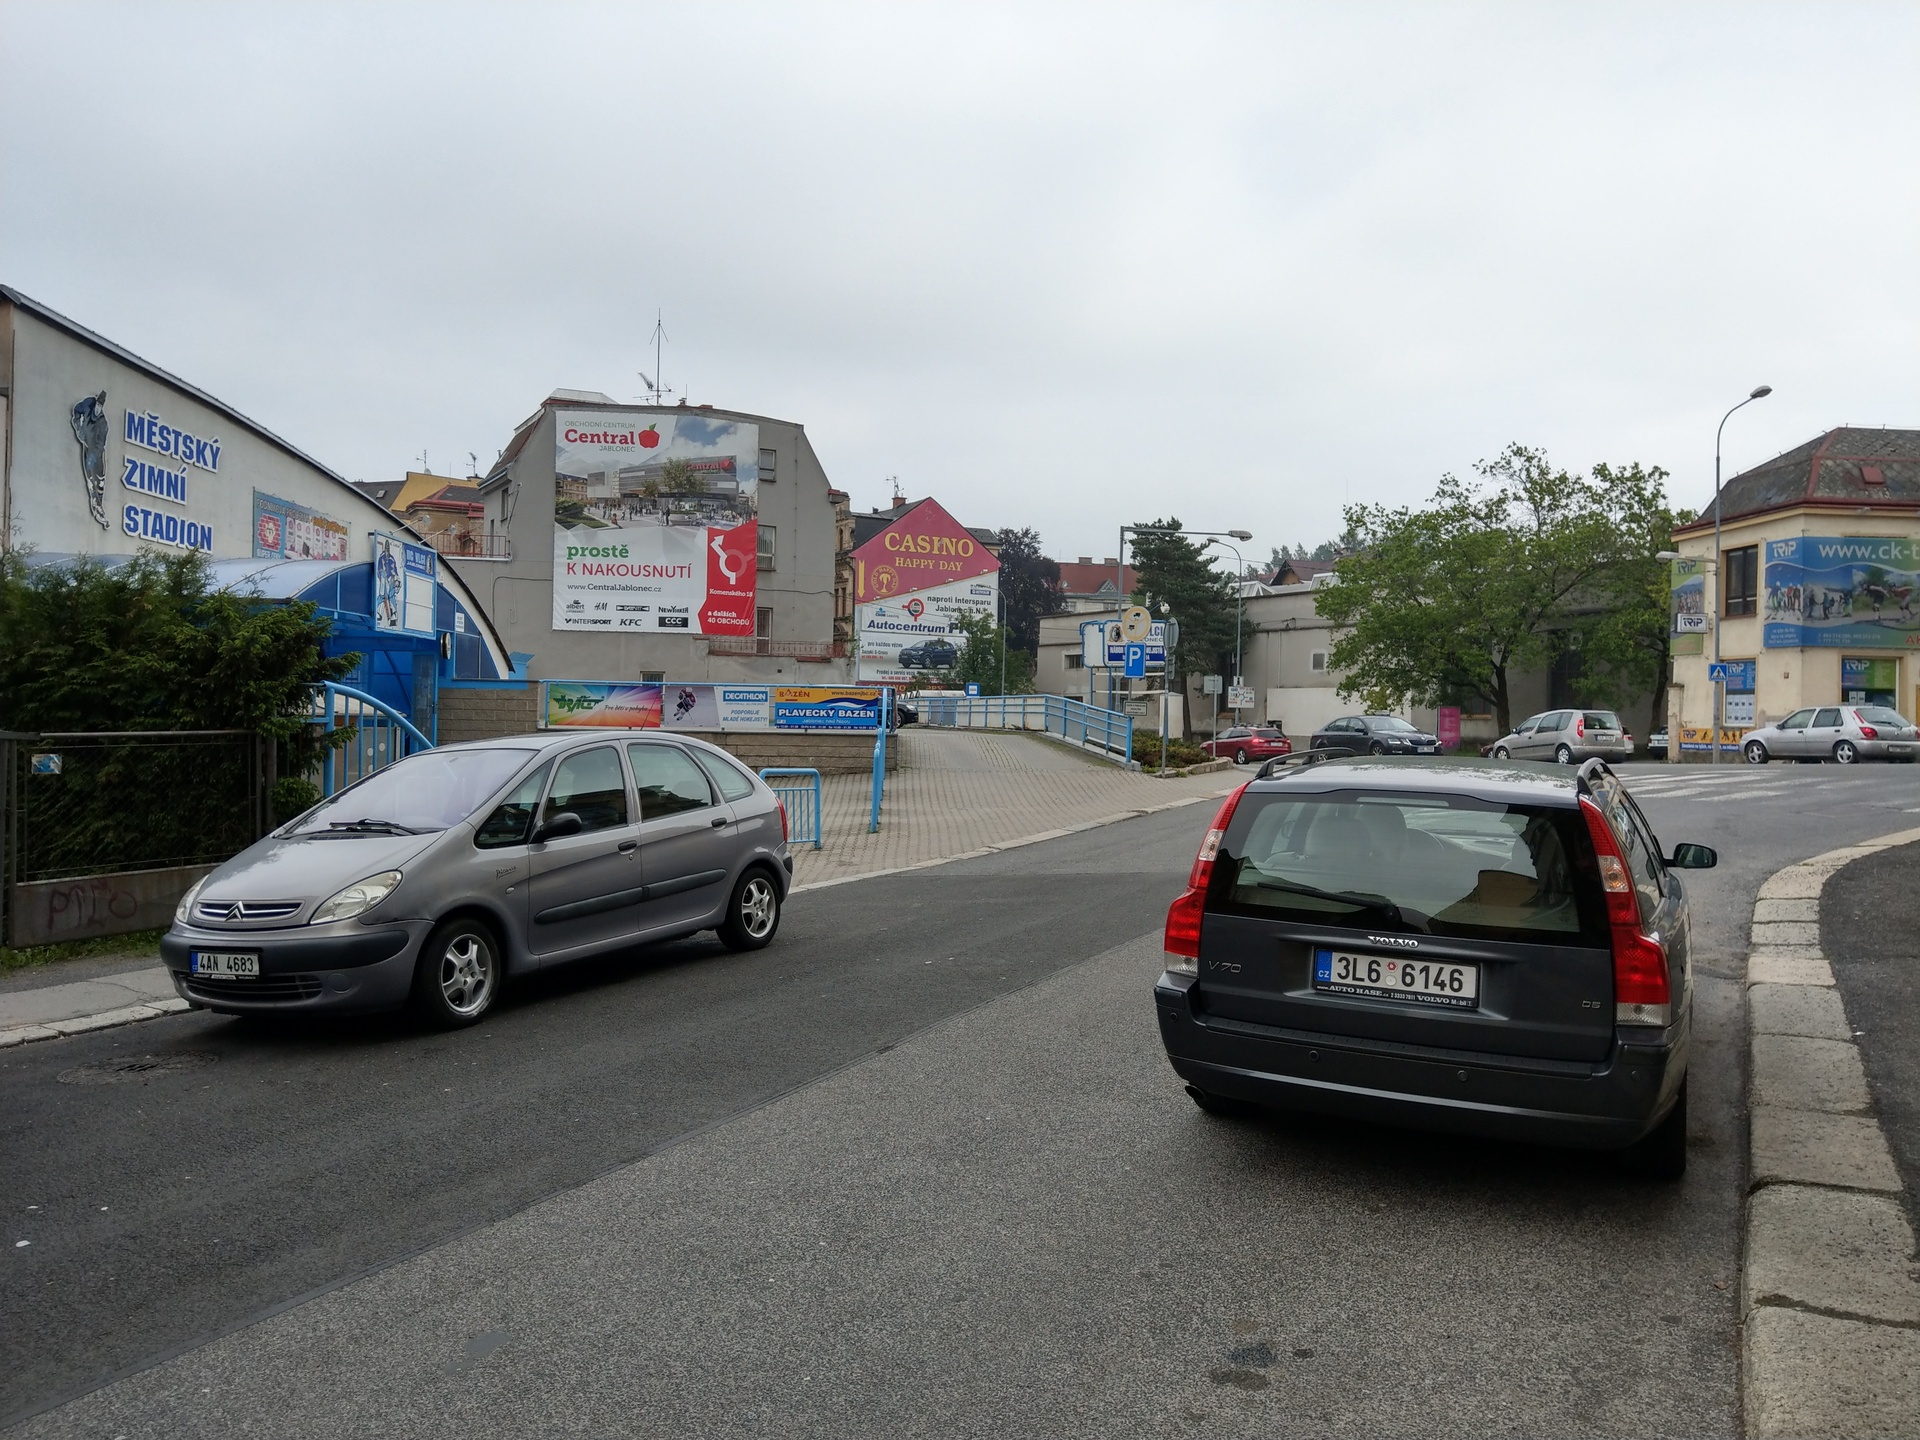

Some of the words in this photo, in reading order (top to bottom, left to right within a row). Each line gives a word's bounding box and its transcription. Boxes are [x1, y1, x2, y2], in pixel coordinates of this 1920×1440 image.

[564, 420, 602, 428] OBCHODNÍ
[126, 411, 221, 470] MĚSTSKÝ
[564, 429, 636, 446] Central
[599, 445, 636, 453] JABLONEC
[124, 458, 187, 502] ZIMNÍ
[124, 505, 213, 552] STADION
[566, 544, 630, 560] prostě
[884, 532, 974, 558] CASINO
[566, 562, 577, 576] K
[582, 562, 692, 579] NAKOUSNUTÍ
[895, 556, 936, 570] HAPPY
[939, 560, 963, 572] DAY
[567, 583, 662, 593] www.CentralJablonec.cz
[927, 596, 953, 604] naproti
[954, 597, 992, 606] Intersparu
[572, 618, 612, 626] INTERSPORT
[618, 618, 643, 627] KFC
[664, 617, 682, 625] CCC
[867, 619, 946, 634] Autocentrum
[1129, 647, 1141, 667] P
[725, 692, 766, 700] DECATHLON
[1367, 935, 1419, 948] VOLVO
[200, 955, 219, 972] 4AN
[226, 956, 254, 973] 4683
[1208, 960, 1242, 973] V70
[1318, 969, 1330, 979] CZ
[1337, 956, 1382, 984] 3L6
[1401, 963, 1464, 993] 6146
[1417, 995, 1450, 1004] VOLVO
